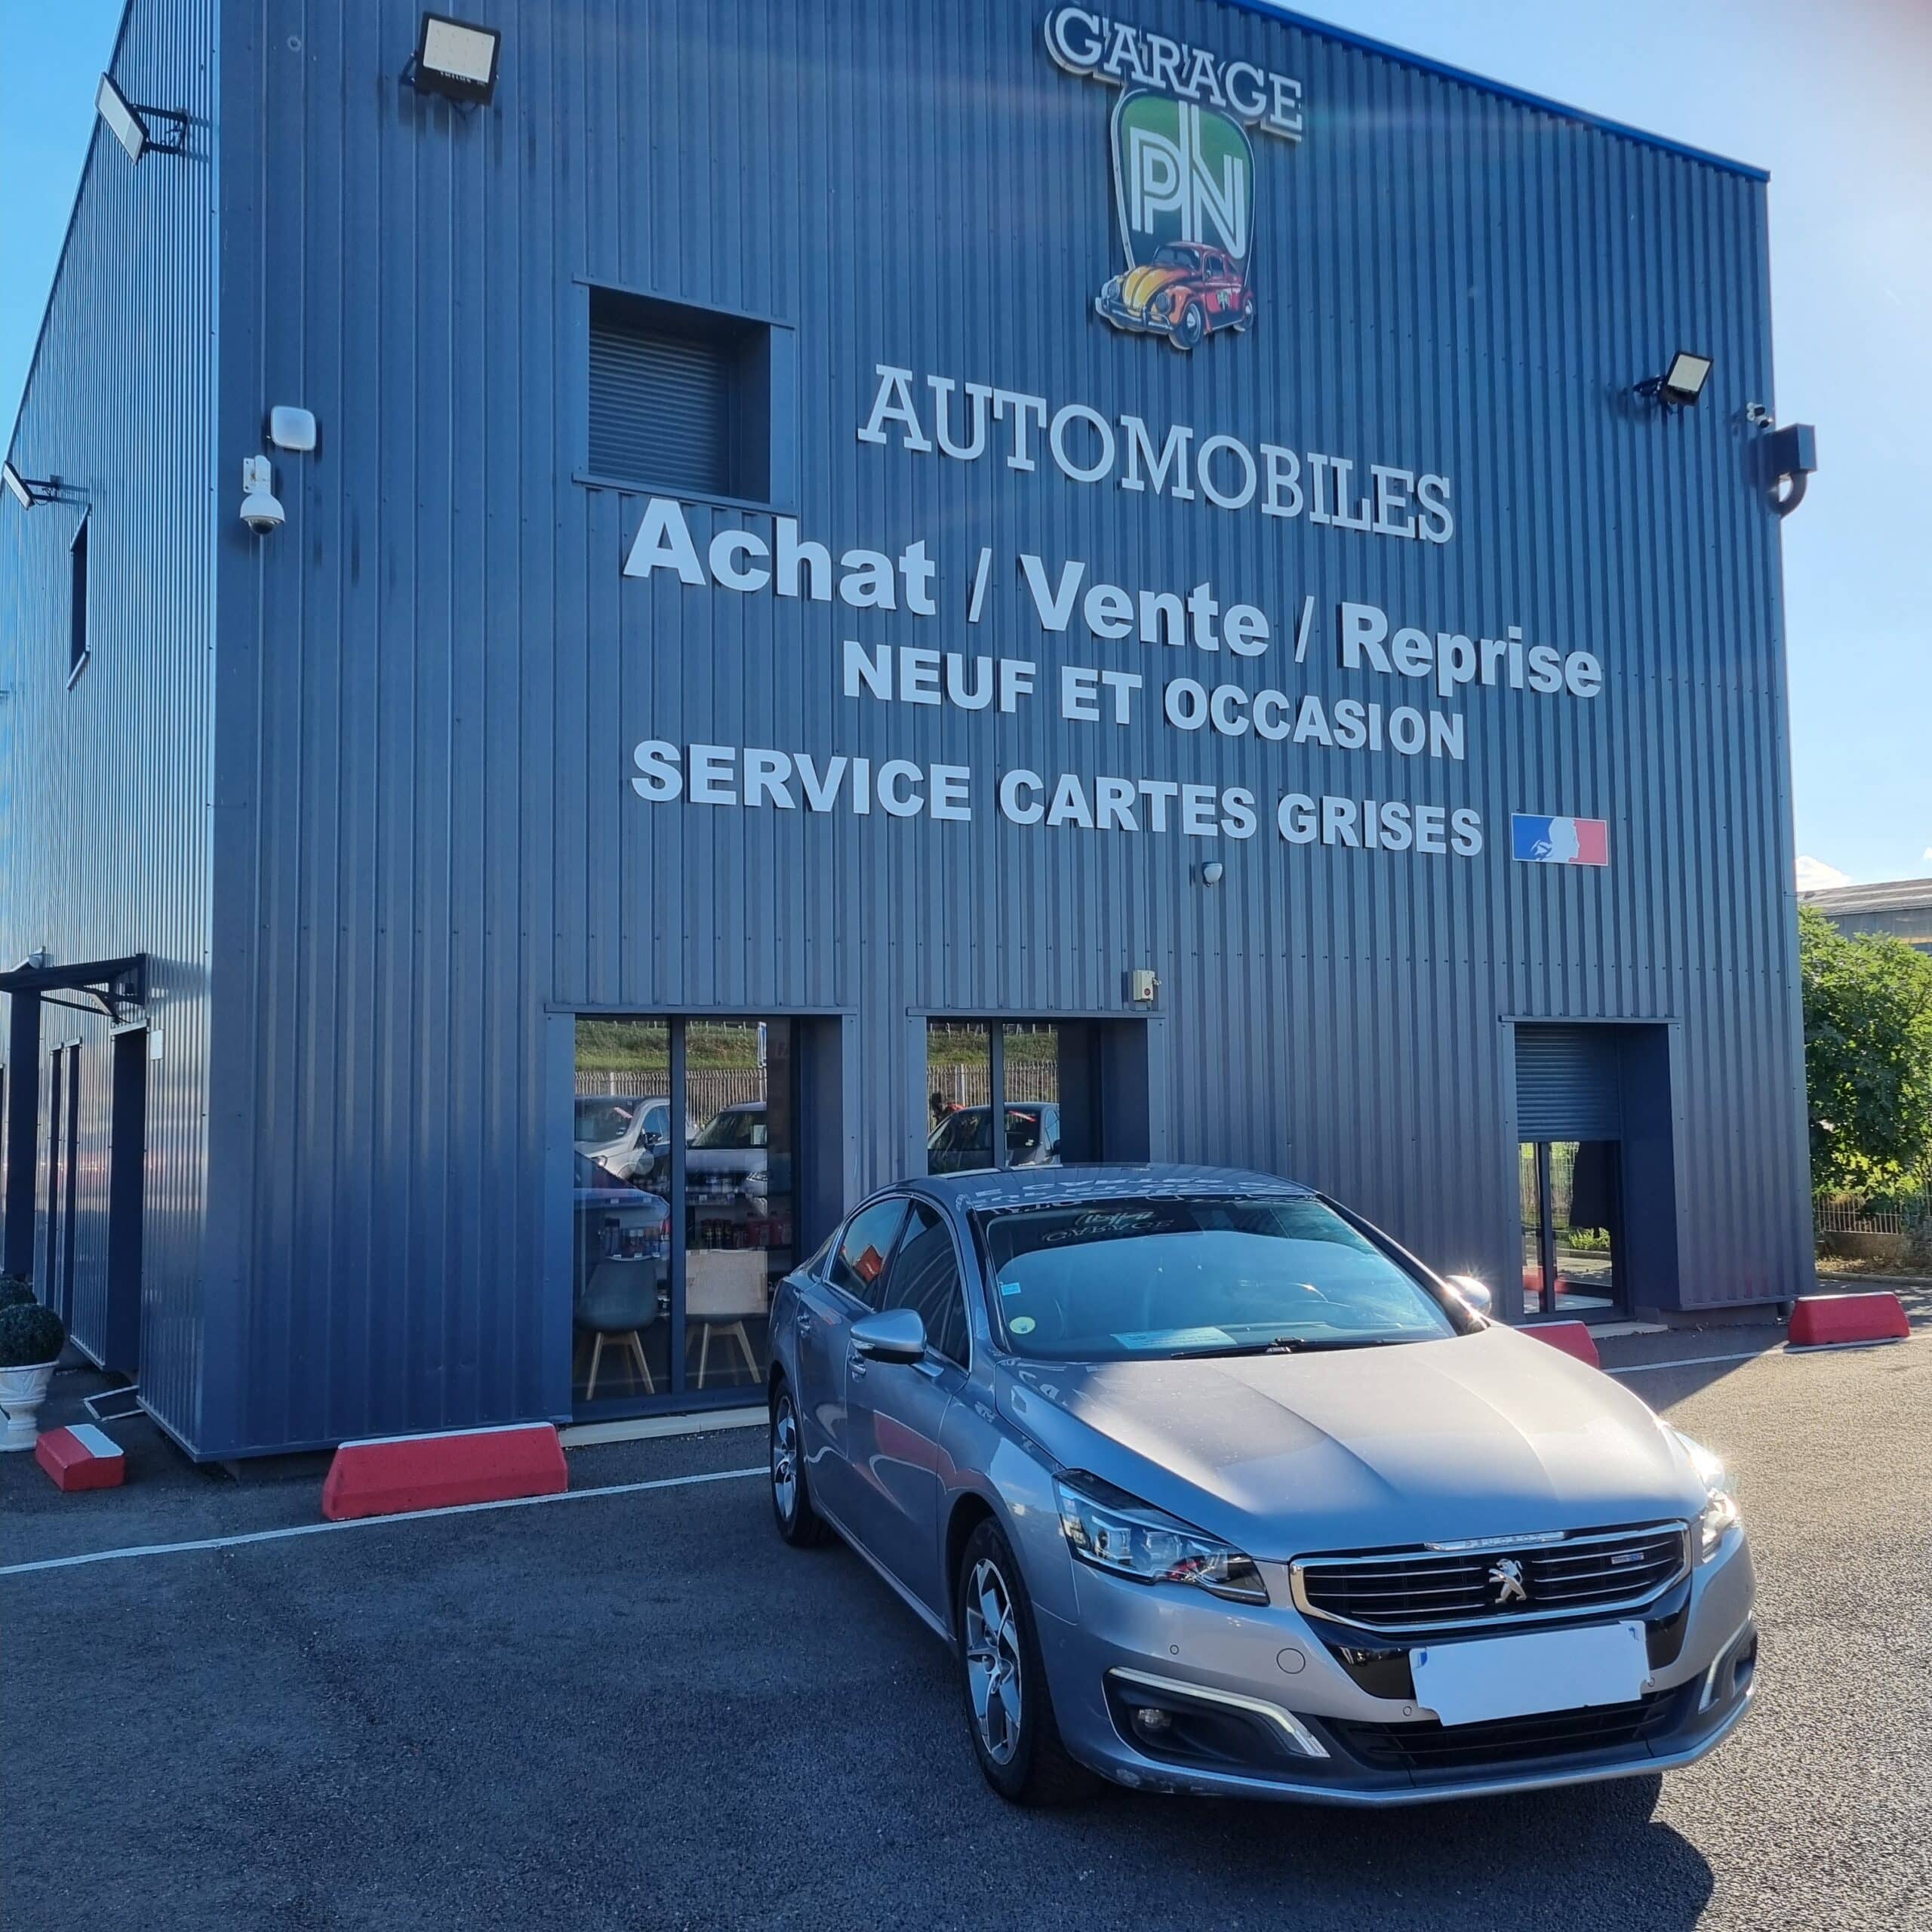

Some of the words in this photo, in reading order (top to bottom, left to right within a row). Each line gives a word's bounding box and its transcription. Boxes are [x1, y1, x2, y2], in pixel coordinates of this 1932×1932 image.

[1054, 6, 1303, 131] GARAGE
[857, 364, 1454, 544] AUTOMOBILES
[623, 497, 937, 616] Achat
[968, 547, 992, 623] /
[1020, 554, 1270, 657] Vente
[1294, 595, 1315, 663] /
[1342, 601, 1602, 698] Reprise
[843, 640, 1036, 713] NEUF
[1061, 666, 1143, 724] ET
[1164, 678, 1464, 760] OCCASION
[631, 740, 971, 821] SERVICE
[1000, 769, 1257, 839] CARTES
[1278, 793, 1483, 857] GRISES
